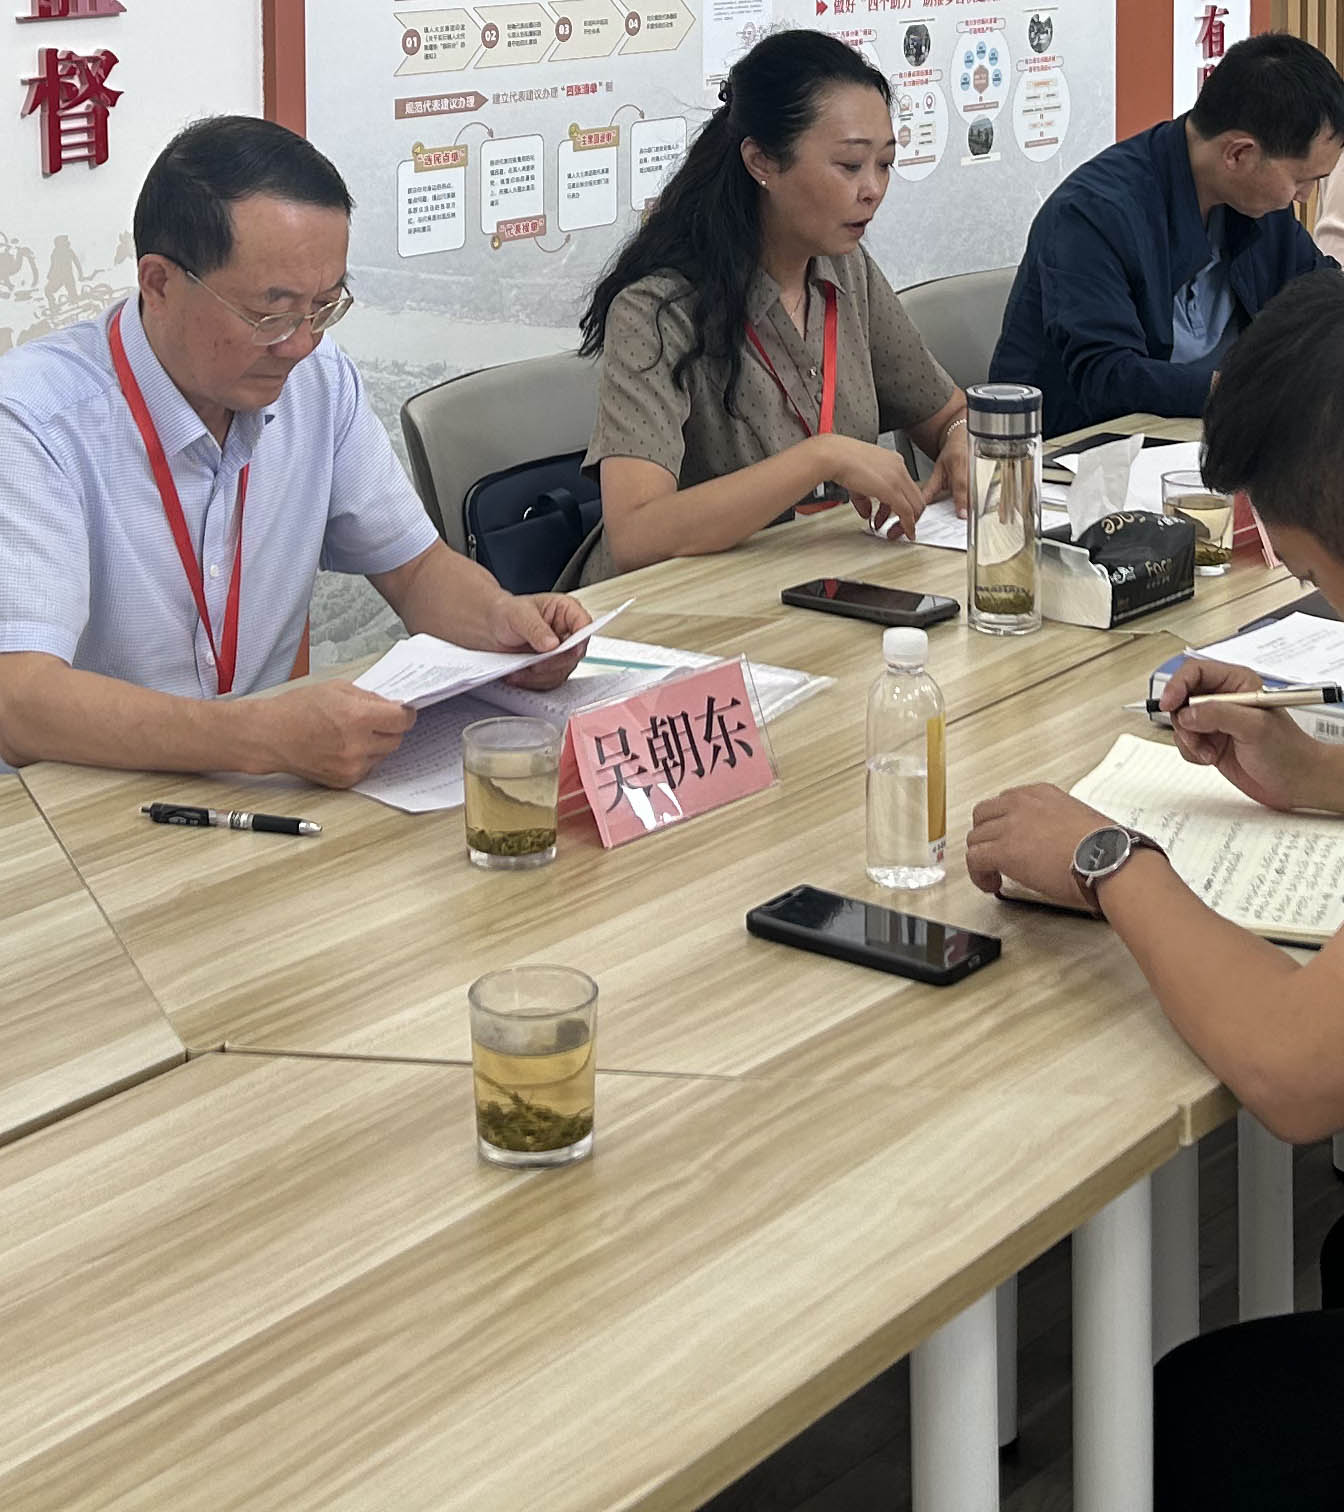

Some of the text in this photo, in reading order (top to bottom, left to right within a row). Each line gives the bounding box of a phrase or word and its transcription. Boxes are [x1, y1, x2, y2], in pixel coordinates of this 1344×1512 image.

[628, 18, 639, 29] 04
[558, 24, 570, 35] 03
[485, 30, 497, 41] 02
[405, 37, 417, 48] 01
[594, 696, 754, 814] 吴朝东
